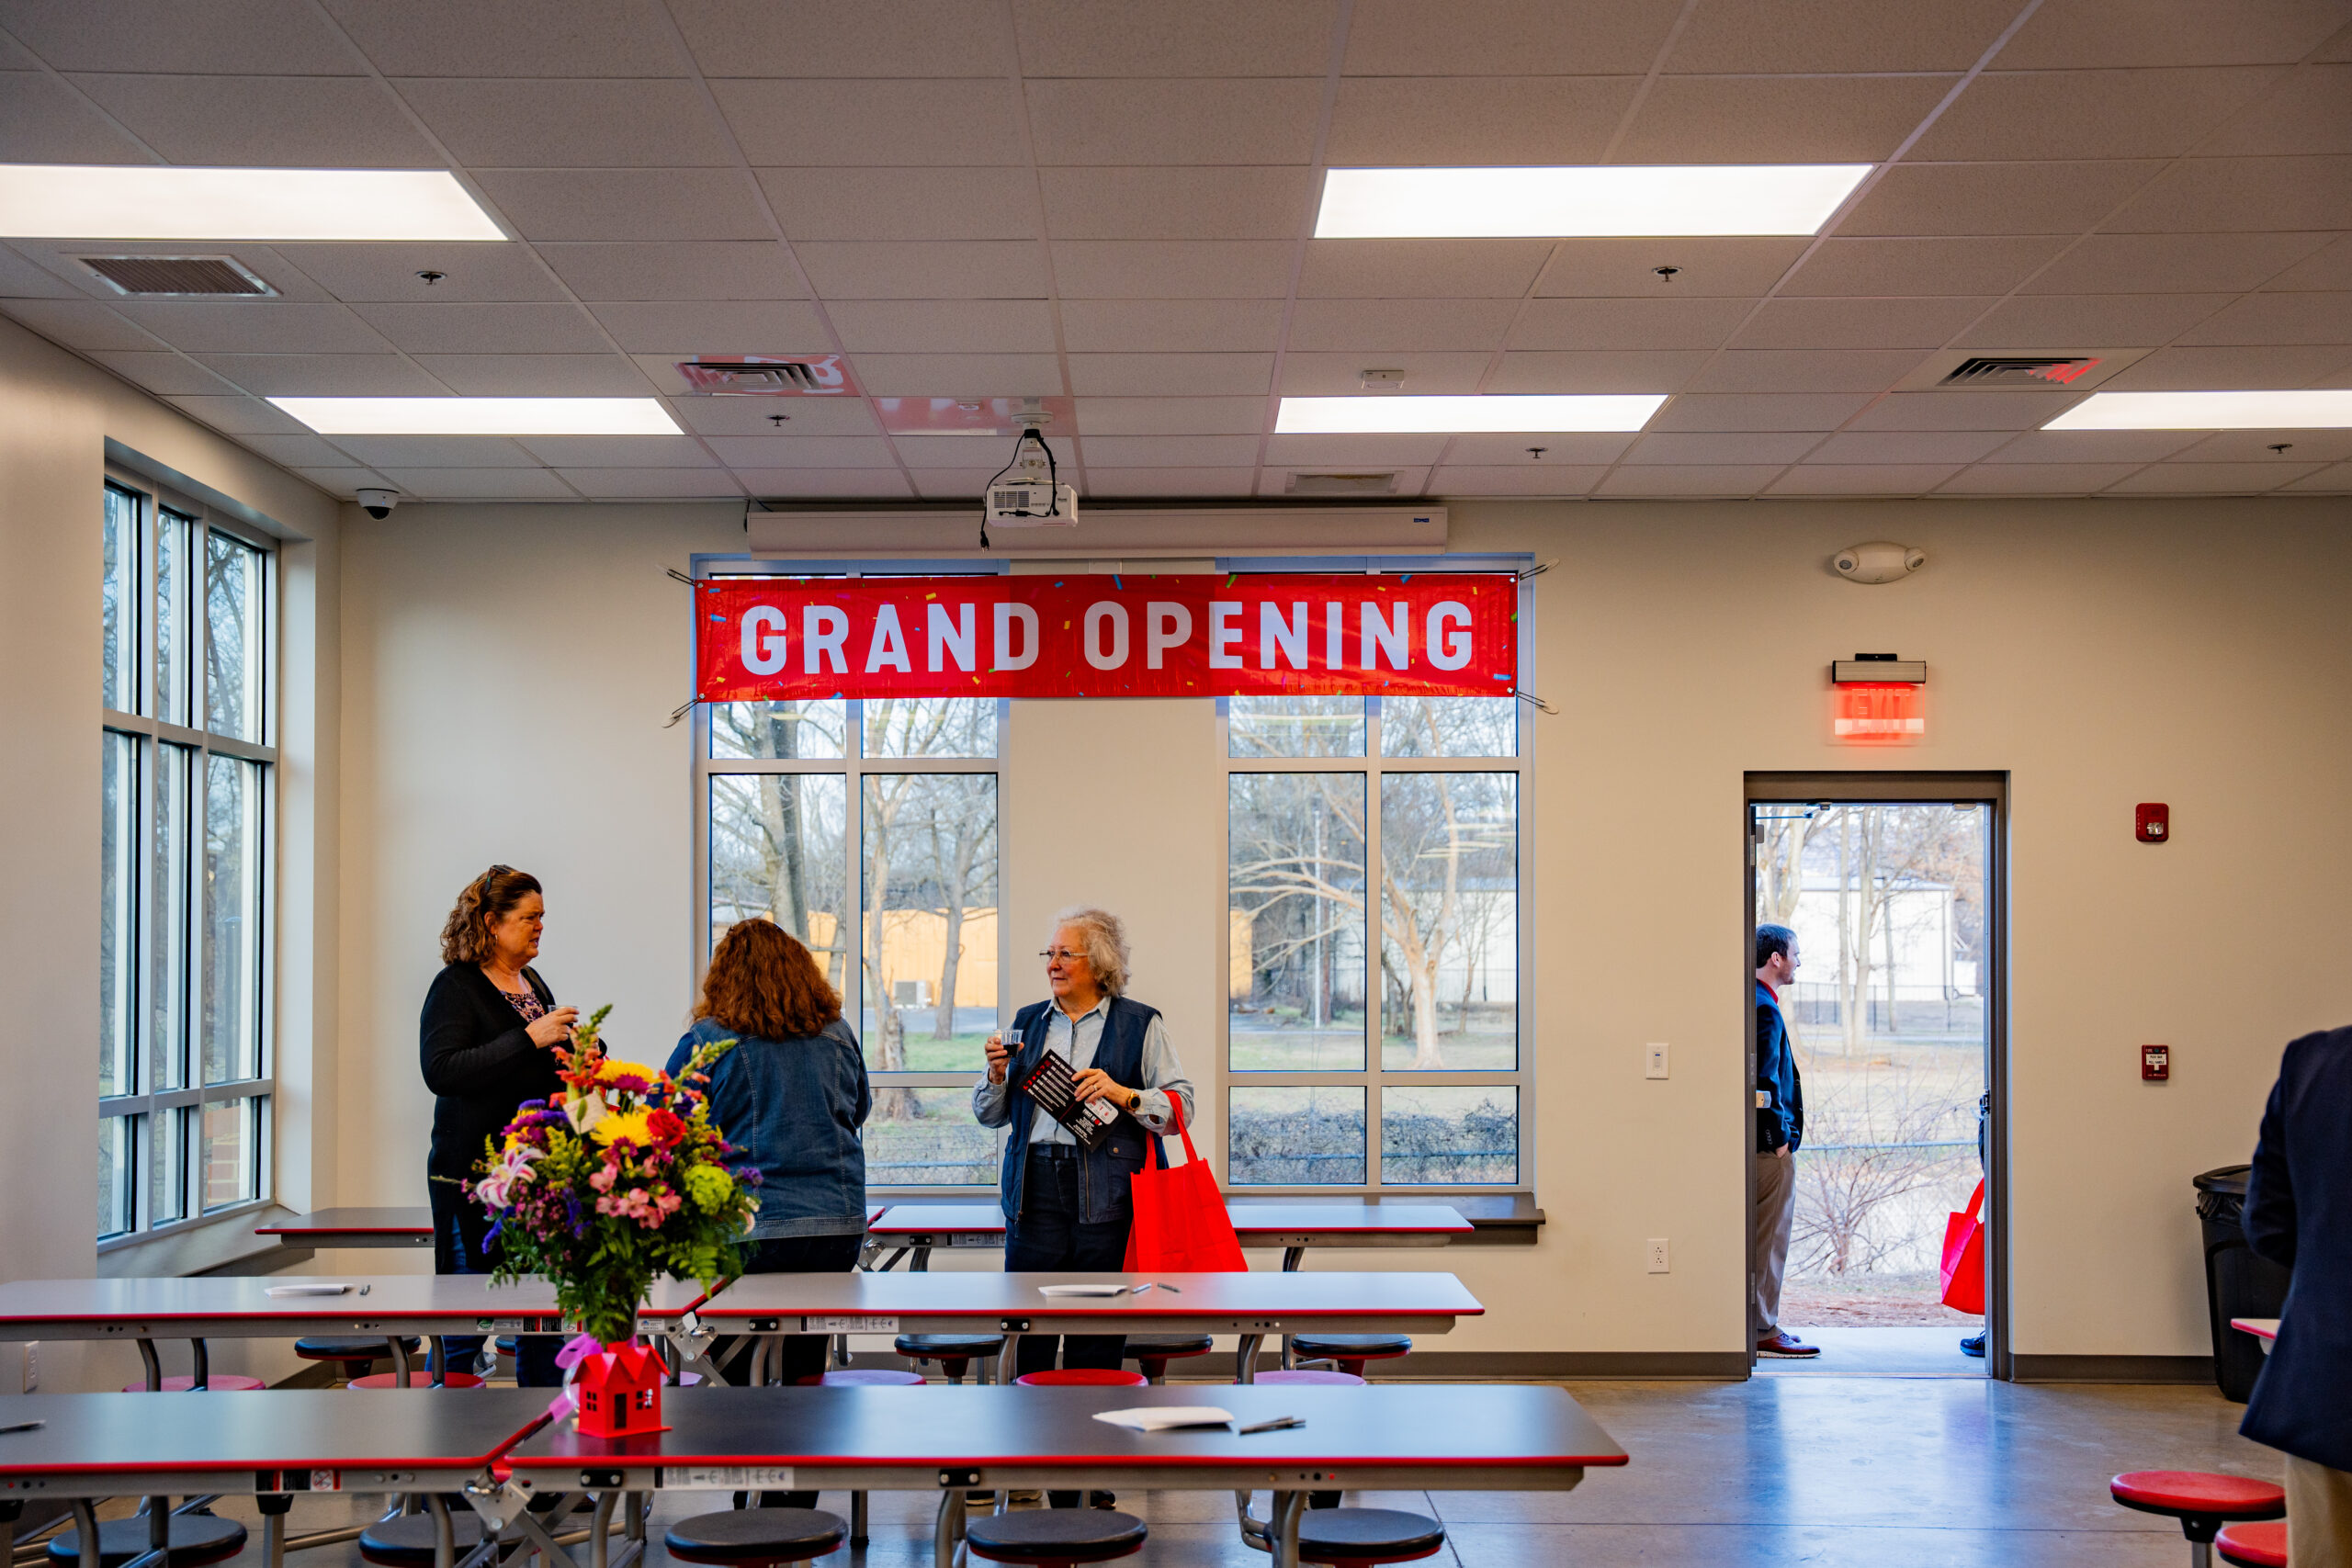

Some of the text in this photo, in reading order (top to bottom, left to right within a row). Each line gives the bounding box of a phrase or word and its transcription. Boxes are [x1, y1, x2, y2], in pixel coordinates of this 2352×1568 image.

[741, 601, 1473, 676] GRAND OPENING
[1852, 688, 1910, 733] EXIT
